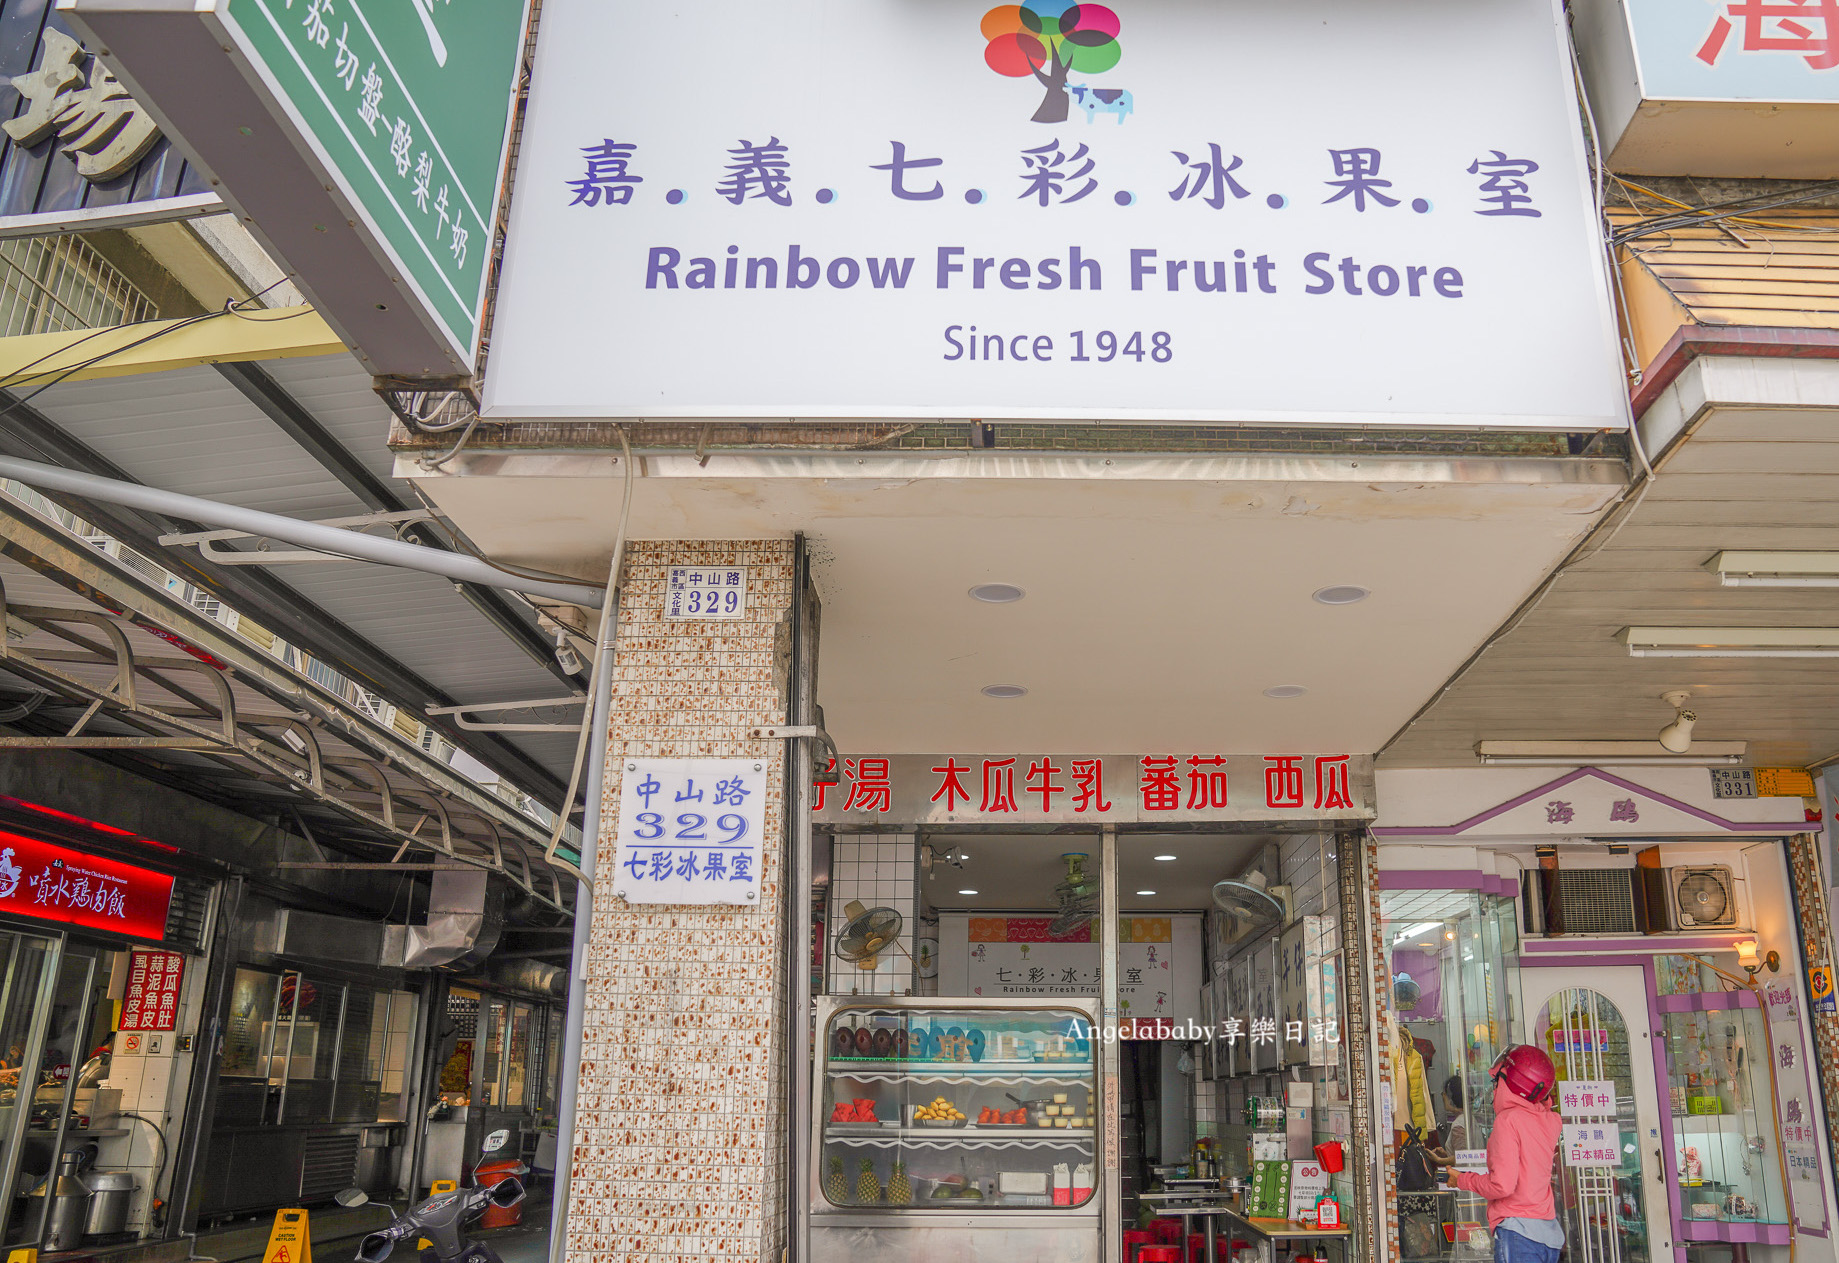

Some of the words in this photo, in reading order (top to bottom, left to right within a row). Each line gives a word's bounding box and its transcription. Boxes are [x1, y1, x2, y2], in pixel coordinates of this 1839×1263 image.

[283, 0, 468, 270] 茄切盤-酪梨牛奶
[646, 245, 914, 289] Rainbow
[937, 247, 1101, 290] Fresh
[1131, 249, 1276, 293] Fruit
[1304, 253, 1463, 298] Store
[944, 326, 1052, 361] Since
[1071, 331, 1172, 362] 1948
[689, 572, 740, 586] 中山路
[670, 592, 682, 616] 文化里
[688, 591, 738, 613] 329
[932, 757, 1112, 813] 木瓜牛乳
[1141, 755, 1228, 811] 蕃茄
[1265, 755, 1354, 809] 西瓜
[1722, 770, 1751, 779] 中山路
[637, 774, 750, 809] 中山路
[1725, 782, 1753, 796] 331
[634, 813, 749, 845] 329
[624, 851, 753, 882] 七彩冰果室
[140, 955, 164, 1028] 蒜泥魚皮
[1564, 1093, 1610, 1108] 特價中
[1784, 1126, 1812, 1141] 特價中
[1571, 1149, 1616, 1161] 日本精品
[1789, 1156, 1817, 1169] 日本精品
